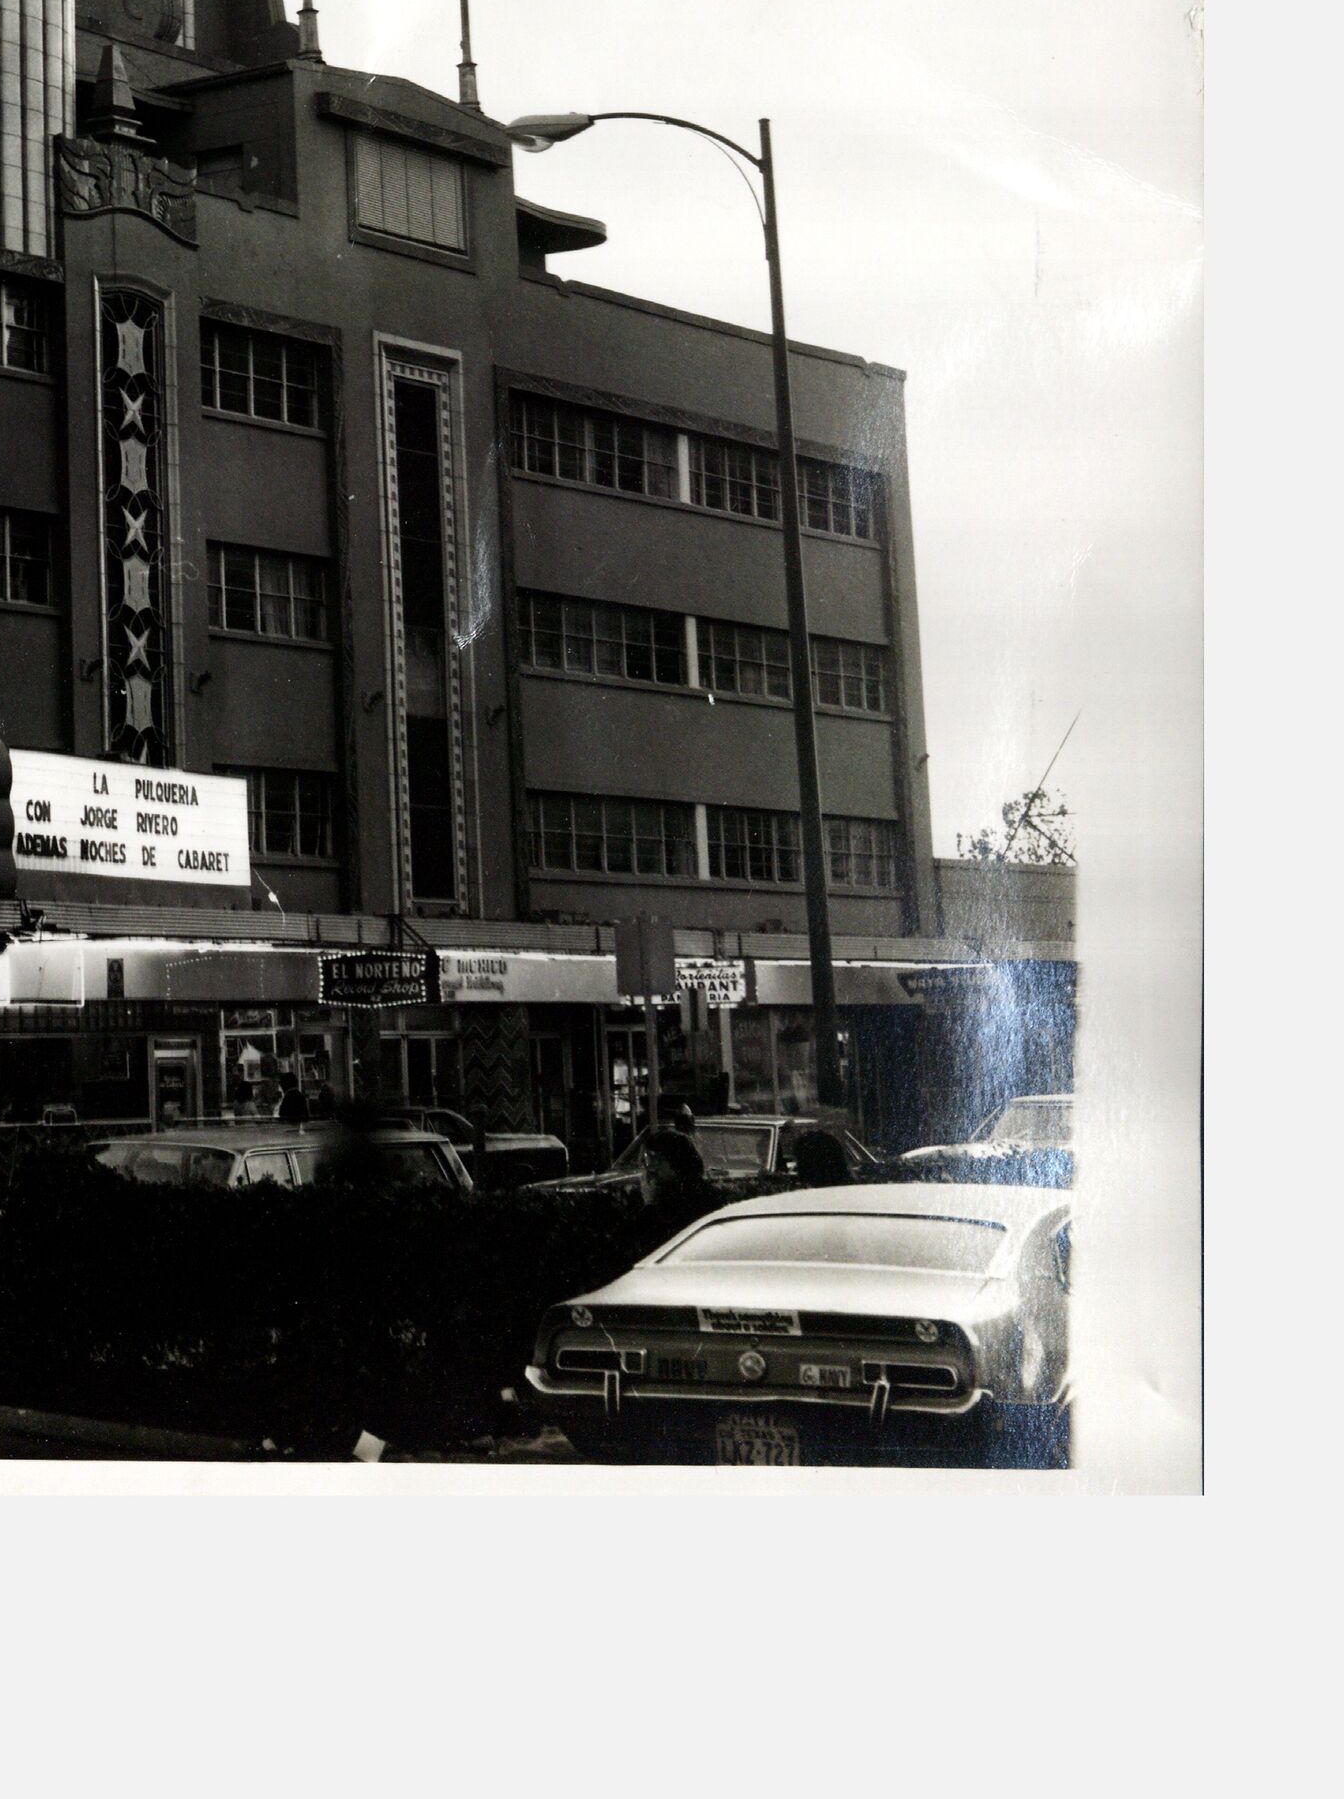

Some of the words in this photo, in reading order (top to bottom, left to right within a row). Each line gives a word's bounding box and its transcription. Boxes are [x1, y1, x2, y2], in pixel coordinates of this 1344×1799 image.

[92, 771, 110, 796] LA
[135, 778, 199, 806] PULQUERIA
[25, 799, 52, 823] CON
[79, 804, 119, 830] JORGE
[136, 811, 178, 837] RIVERO
[17, 831, 68, 858] ADEMAS
[79, 838, 127, 864] NOCHES
[141, 845, 157, 867] DE
[177, 848, 230, 872] CABARET
[331, 964, 349, 980] EL
[354, 958, 422, 979] NORTEÑO
[379, 979, 419, 995] Shop
